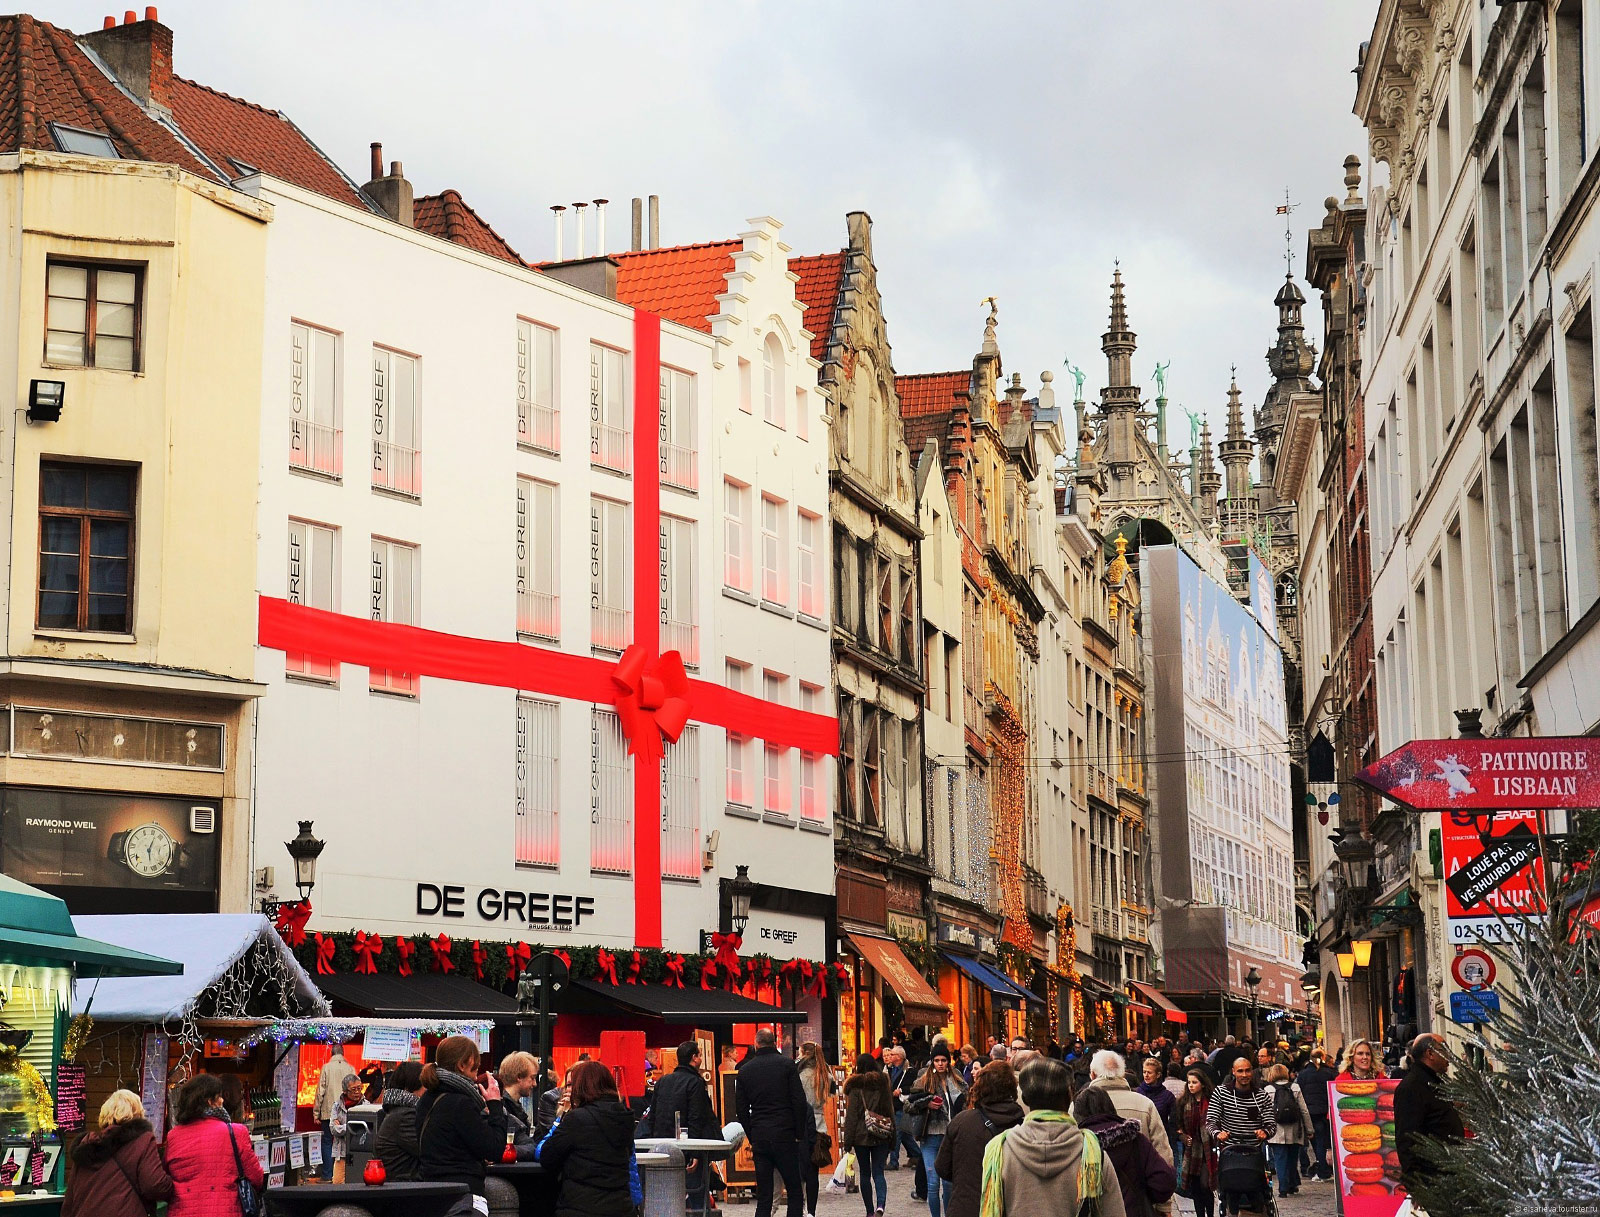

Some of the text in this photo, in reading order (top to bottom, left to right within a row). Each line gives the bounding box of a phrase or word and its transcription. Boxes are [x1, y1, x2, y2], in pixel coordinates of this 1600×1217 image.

[292, 335, 302, 414] GREEF
[517, 329, 527, 400] GREEF
[374, 359, 384, 435] GREEF
[590, 353, 599, 422] GREEF
[517, 488, 526, 560] GREEF
[591, 507, 599, 577] GREEF
[659, 525, 668, 593] GREEF
[1480, 751, 1588, 771] PATINOIRE
[1493, 777, 1577, 796] IJSBAAN
[26, 818, 97, 830] RAYMOND WEIL
[1487, 810, 1537, 821] ERARD
[1460, 861, 1511, 903] VERHUURD
[1466, 854, 1493, 881] LOUÉ
[416, 882, 595, 926] DE GREEF
[528, 923, 558, 932] BRUSSELS
[760, 927, 798, 942] DE GREEF
[1454, 924, 1472, 938] 02
[1476, 923, 1502, 937] 513
[273, 1145, 286, 1165] VIN
